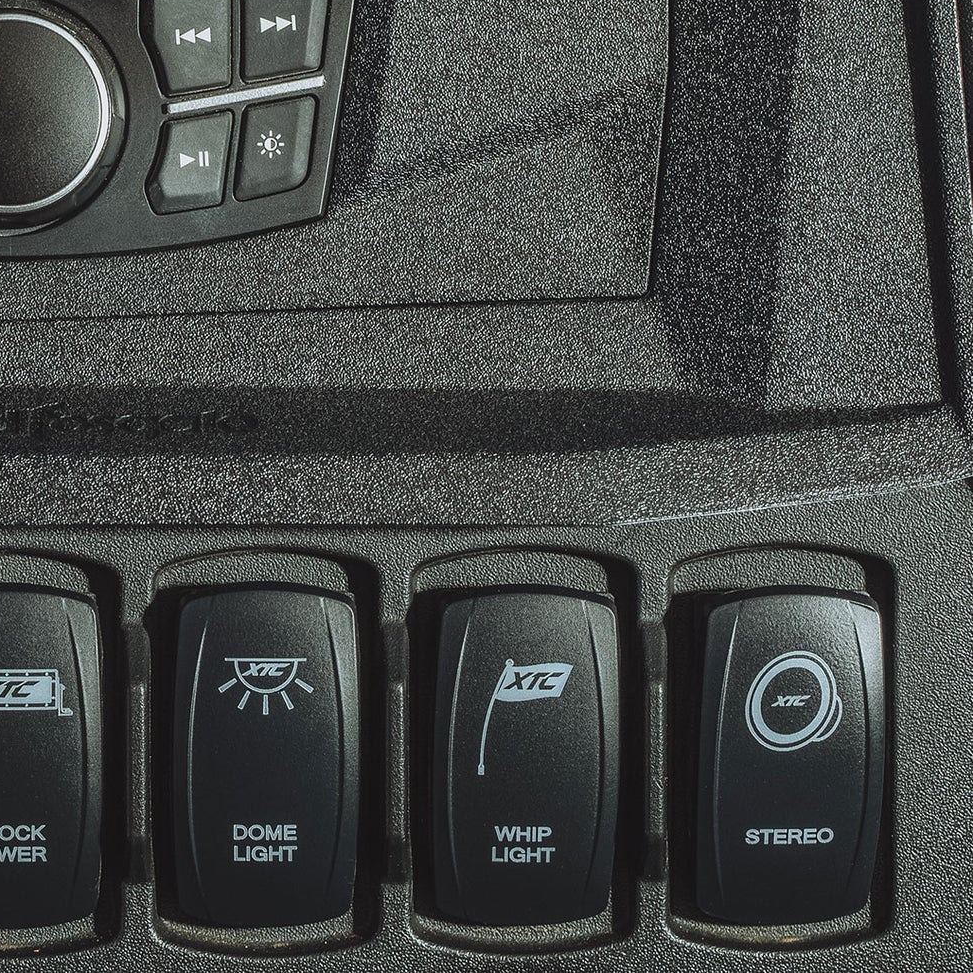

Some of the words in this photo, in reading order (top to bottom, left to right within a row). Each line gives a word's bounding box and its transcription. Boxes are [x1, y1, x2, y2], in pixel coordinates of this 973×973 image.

[241, 662, 291, 677] XTC
[503, 671, 565, 691] XTC
[770, 694, 812, 707] XTC
[233, 823, 298, 841] DOME
[494, 825, 553, 843] WHIP
[744, 827, 835, 845] STEREO
[233, 844, 298, 862] LIGHT
[491, 846, 556, 864] LIGHT
